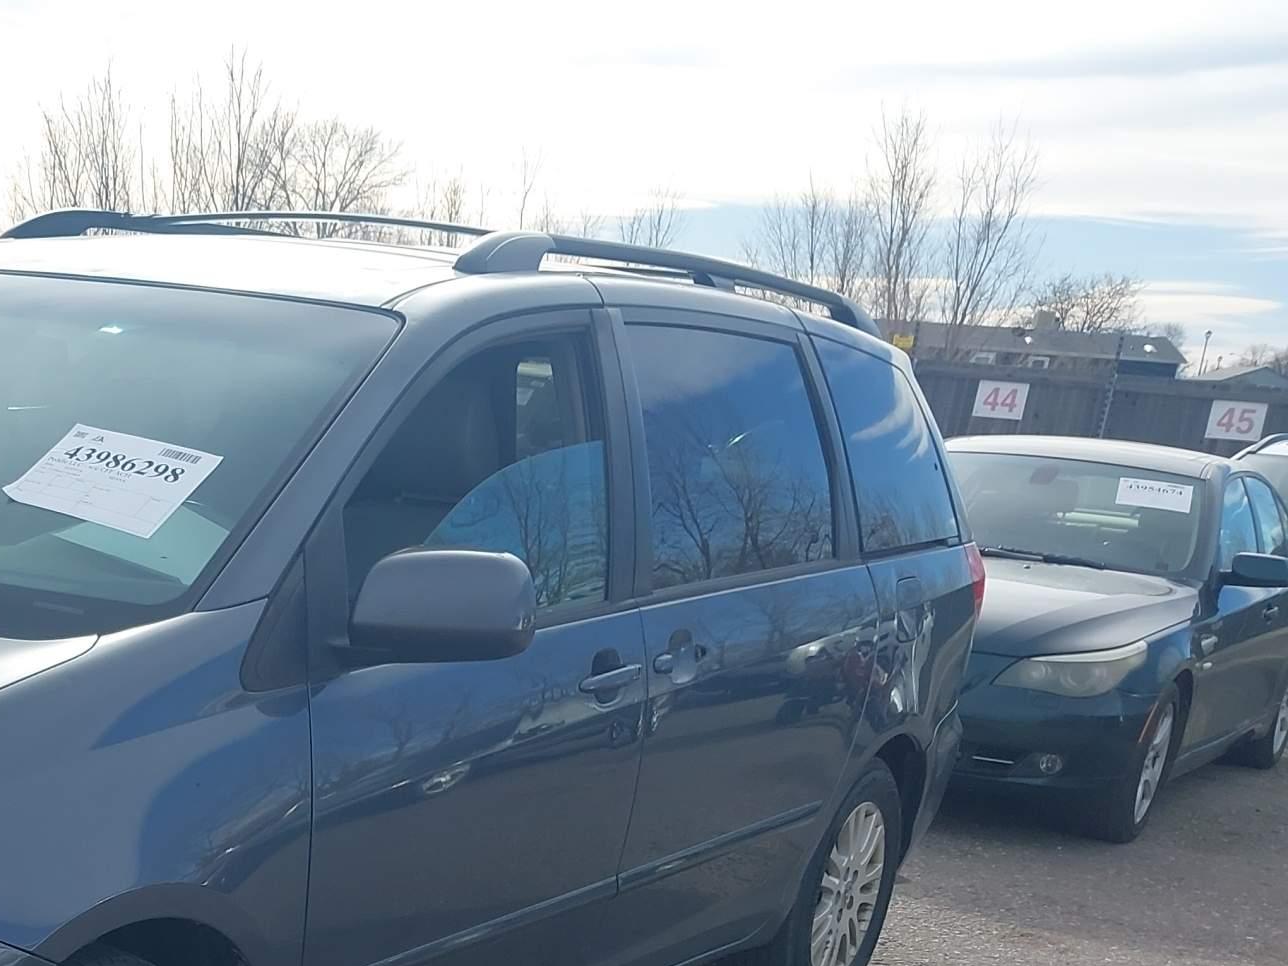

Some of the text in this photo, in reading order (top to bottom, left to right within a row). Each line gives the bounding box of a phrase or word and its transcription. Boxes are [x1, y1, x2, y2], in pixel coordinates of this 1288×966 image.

[983, 387, 1018, 413] 44
[1215, 407, 1257, 435] 45
[64, 446, 186, 484] 43986298
